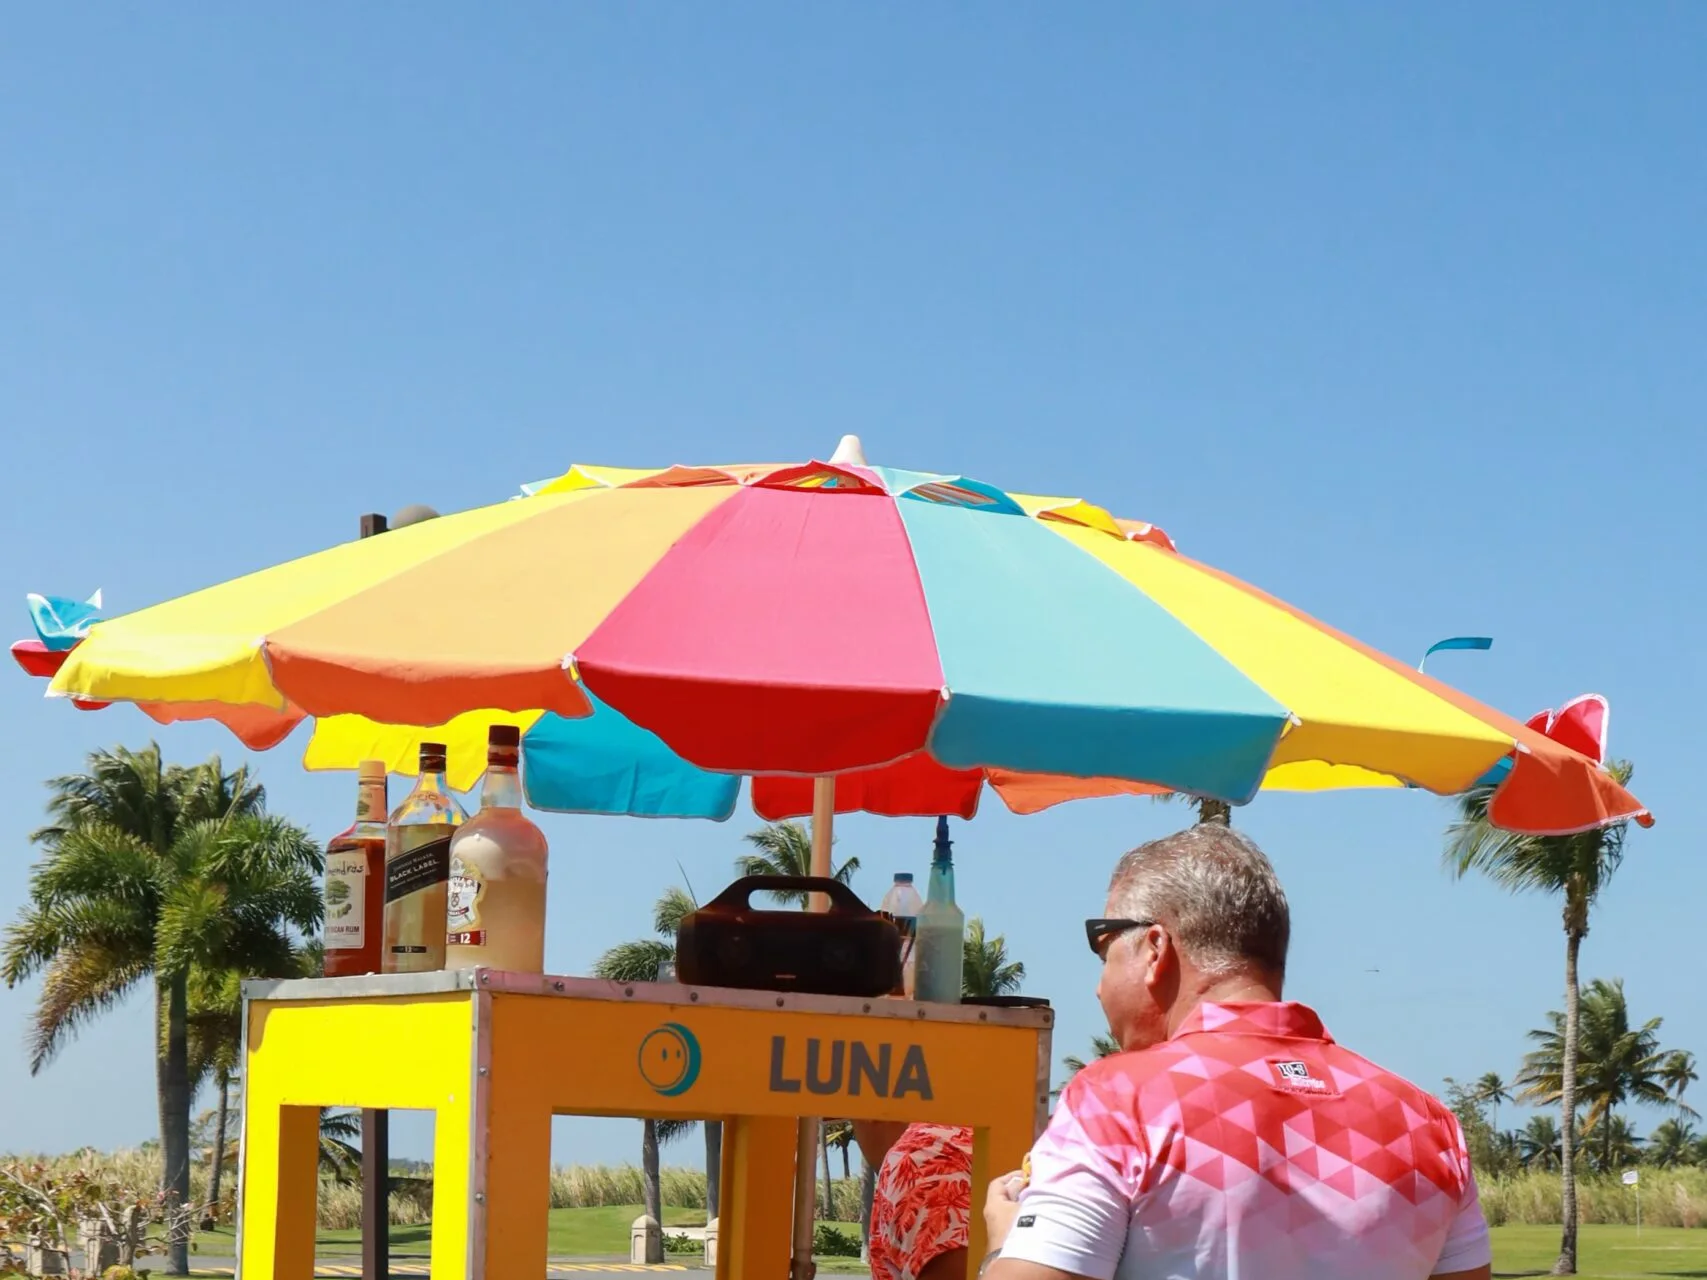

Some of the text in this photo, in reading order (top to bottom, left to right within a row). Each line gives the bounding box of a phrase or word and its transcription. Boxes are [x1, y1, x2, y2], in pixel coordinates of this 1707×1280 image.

[389, 867, 413, 883] BLACK
[413, 858, 439, 873] LABEL
[346, 925, 360, 933] RUM
[460, 933, 472, 944] 12
[769, 1034, 935, 1102] LUNA
